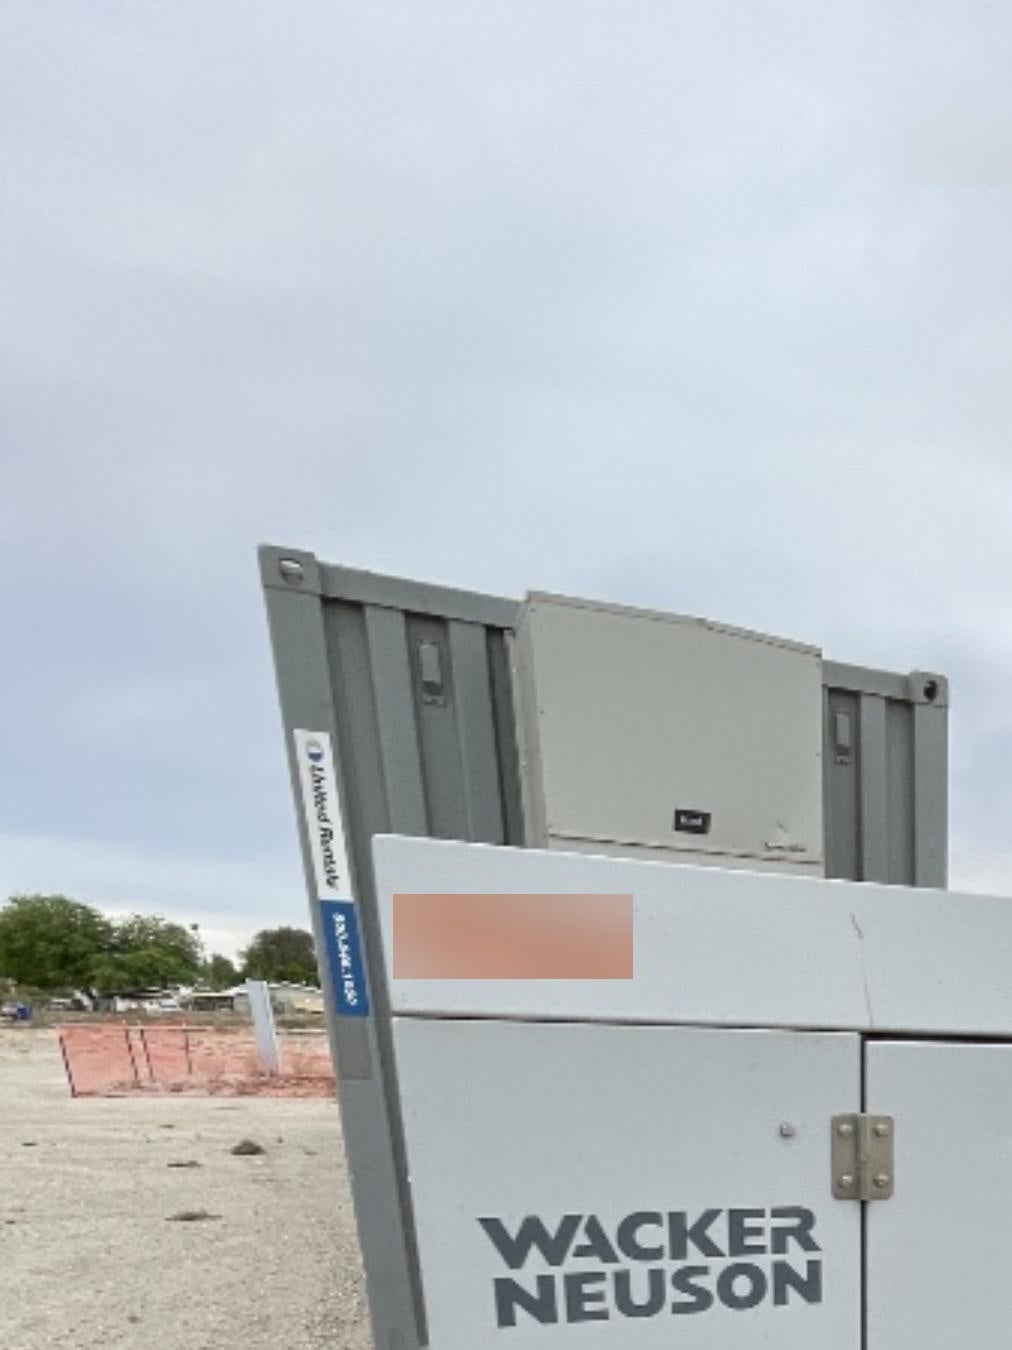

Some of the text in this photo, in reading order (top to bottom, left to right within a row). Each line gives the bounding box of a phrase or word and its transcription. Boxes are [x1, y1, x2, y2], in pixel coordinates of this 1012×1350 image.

[309, 763, 340, 890] United Rentals
[477, 1206, 822, 1269] WACKER
[493, 1260, 822, 1329] NEUSON
